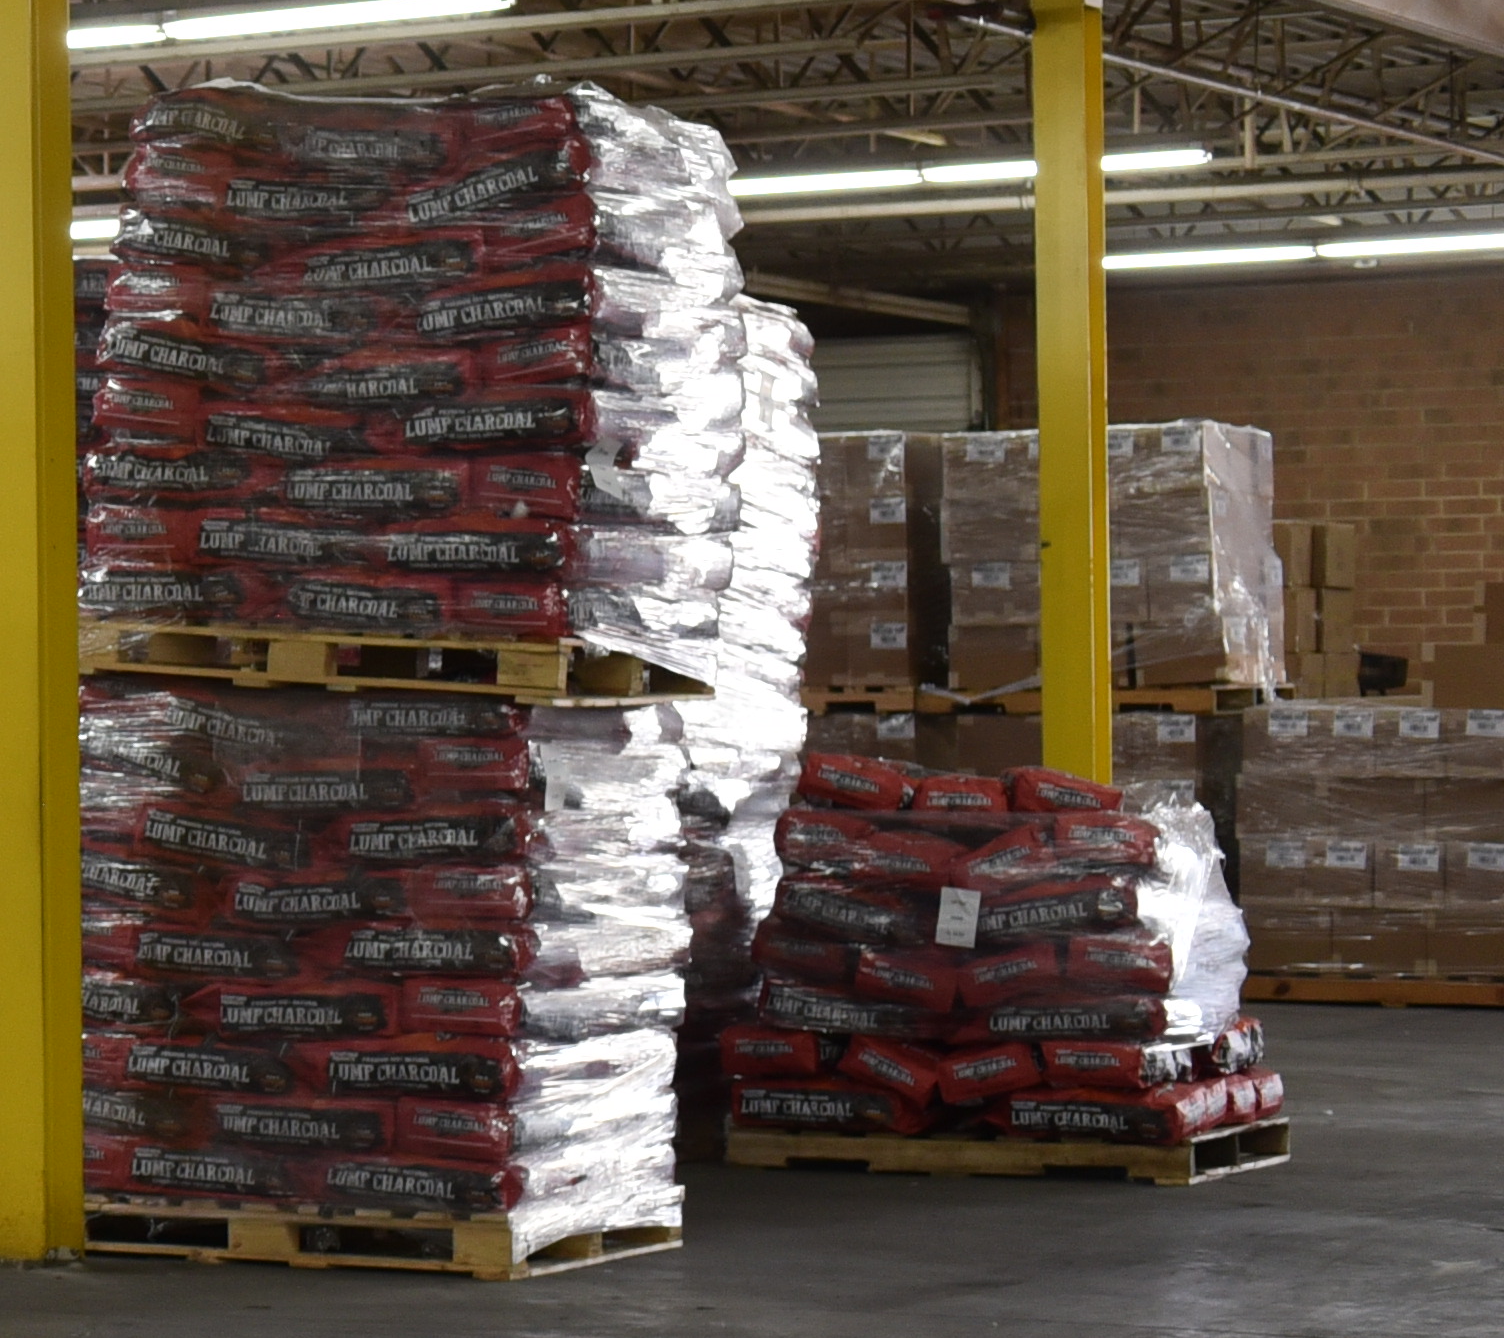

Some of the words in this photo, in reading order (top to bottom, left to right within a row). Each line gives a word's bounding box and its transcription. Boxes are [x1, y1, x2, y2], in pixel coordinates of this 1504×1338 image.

[227, 191, 269, 207] LUMP
[271, 192, 349, 209] CHARCOAL
[409, 196, 452, 222] LUMP
[454, 166, 538, 207] CHARCOAL
[154, 231, 230, 257] CHARCOAL
[349, 257, 432, 279] CHARCOAL
[255, 308, 333, 327] CHARCOAL
[462, 296, 545, 323] CHARCOAL
[150, 346, 224, 374] CHARCOAL
[346, 378, 418, 398] HARCOAL
[406, 416, 451, 437] LUMP
[455, 411, 536, 432] CHARCOAL
[252, 431, 331, 455] CHARCOAL
[332, 483, 414, 501] CHARCOAL
[201, 532, 244, 548] LUMP
[388, 544, 434, 561] LUMP
[436, 544, 520, 562] CHARCOAL
[122, 585, 203, 601] CHARCOAL
[316, 594, 398, 618] CHARCOAL
[386, 710, 466, 726] CHARCOAL
[242, 783, 287, 802] LUMP
[289, 783, 368, 802] CHARCOAL
[145, 821, 186, 843] LUMP
[188, 829, 266, 859] CHARCOAL
[350, 833, 395, 851] LUMP
[397, 829, 478, 849] CHARCOAL
[235, 893, 279, 912] LUMP
[281, 891, 361, 913] CHARCOAL
[1009, 902, 1088, 926] CHARCOAL
[174, 947, 252, 968] CHARCOAL
[345, 941, 390, 959] LUMP
[392, 941, 474, 960] CHARCOAL
[418, 994, 442, 1004] LUMP
[444, 996, 490, 1007] CHARCOAL
[220, 1006, 262, 1024] LUMP
[264, 1006, 343, 1025] CHARCOAL
[990, 1016, 1031, 1031] LUMP
[1033, 1014, 1110, 1030] CHARCOAL
[128, 1056, 170, 1074] LUMP
[172, 1061, 250, 1083] CHARCOAL
[377, 1064, 460, 1084] CHARCOAL
[741, 1099, 780, 1114] LUMP
[783, 1101, 853, 1117] CHARCOAL
[259, 1118, 340, 1139] CHARCOAL
[1011, 1111, 1051, 1125] LUMP
[1055, 1113, 1128, 1130] CHARCOAL
[132, 1159, 175, 1178] LUMP
[177, 1163, 255, 1185] CHARCOAL
[327, 1168, 371, 1189] LUMP
[373, 1174, 455, 1199] CHARCOAL
